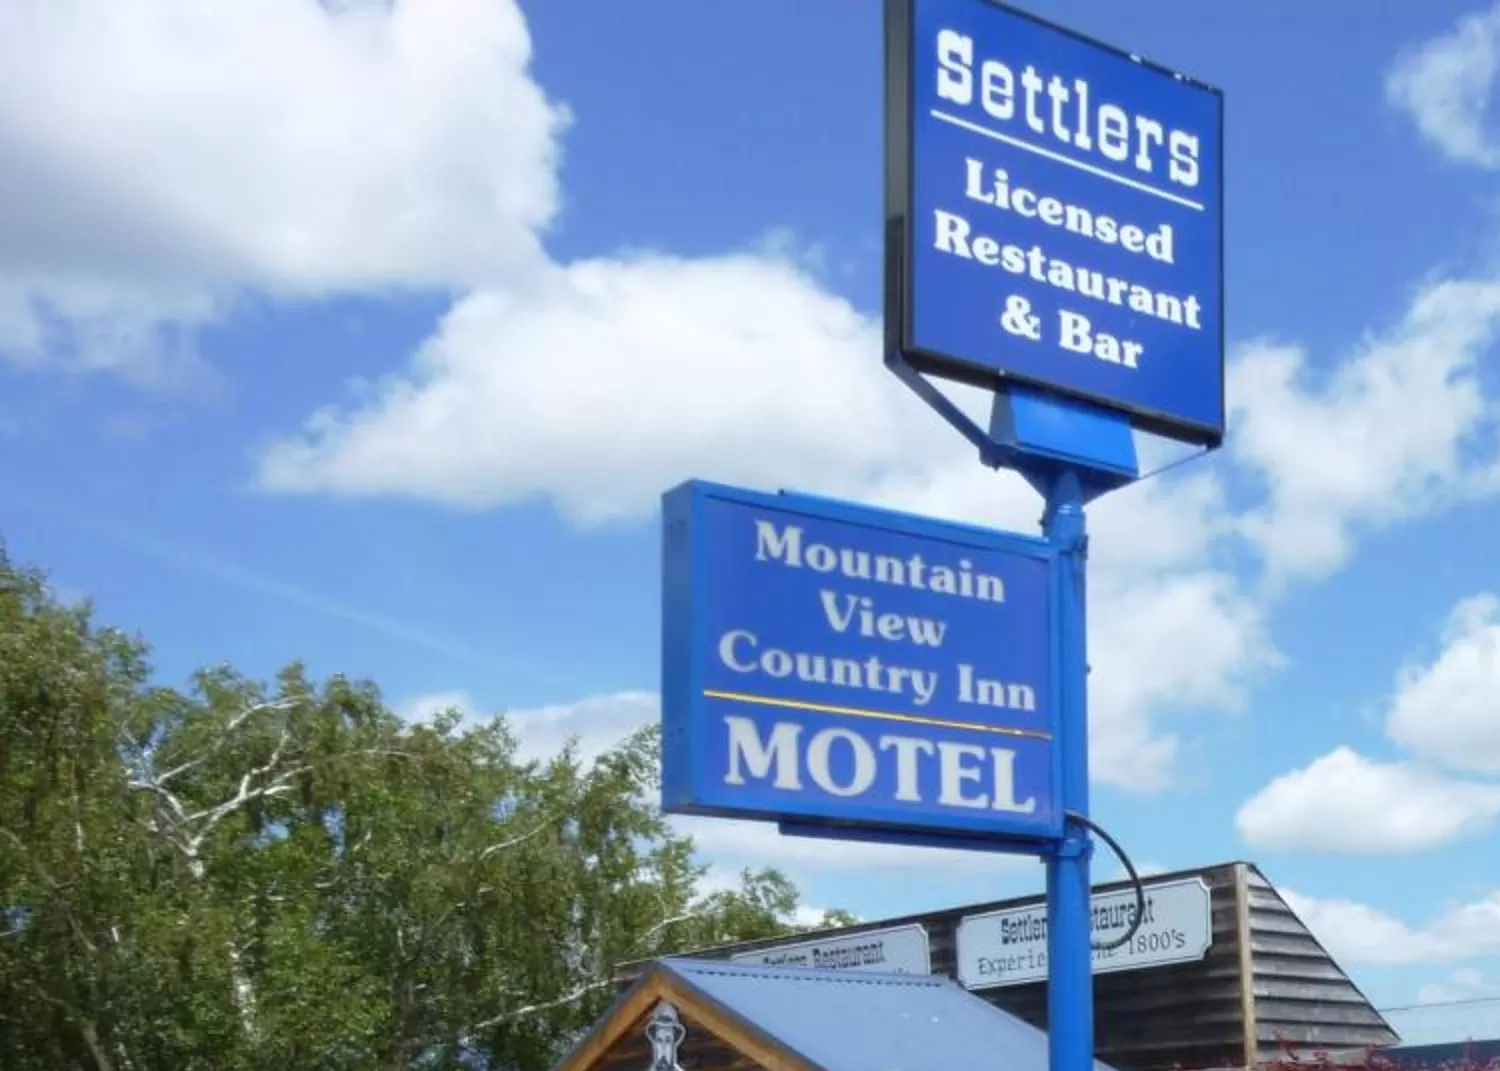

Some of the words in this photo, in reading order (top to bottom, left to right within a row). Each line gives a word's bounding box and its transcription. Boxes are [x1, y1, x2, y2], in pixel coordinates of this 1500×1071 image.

[936, 29, 1200, 188] Settlers
[965, 157, 1175, 264] Licensed
[933, 209, 1201, 329] Restaurant
[1001, 295, 1041, 341] &
[1058, 309, 1144, 369] Bar
[755, 520, 1005, 602] Mountain
[820, 589, 947, 647] View
[718, 630, 938, 705] Country
[957, 664, 1036, 711] Inn
[724, 716, 1036, 814] MOTEL
[978, 948, 1045, 976] Experie
[1001, 914, 1047, 944] Settler
